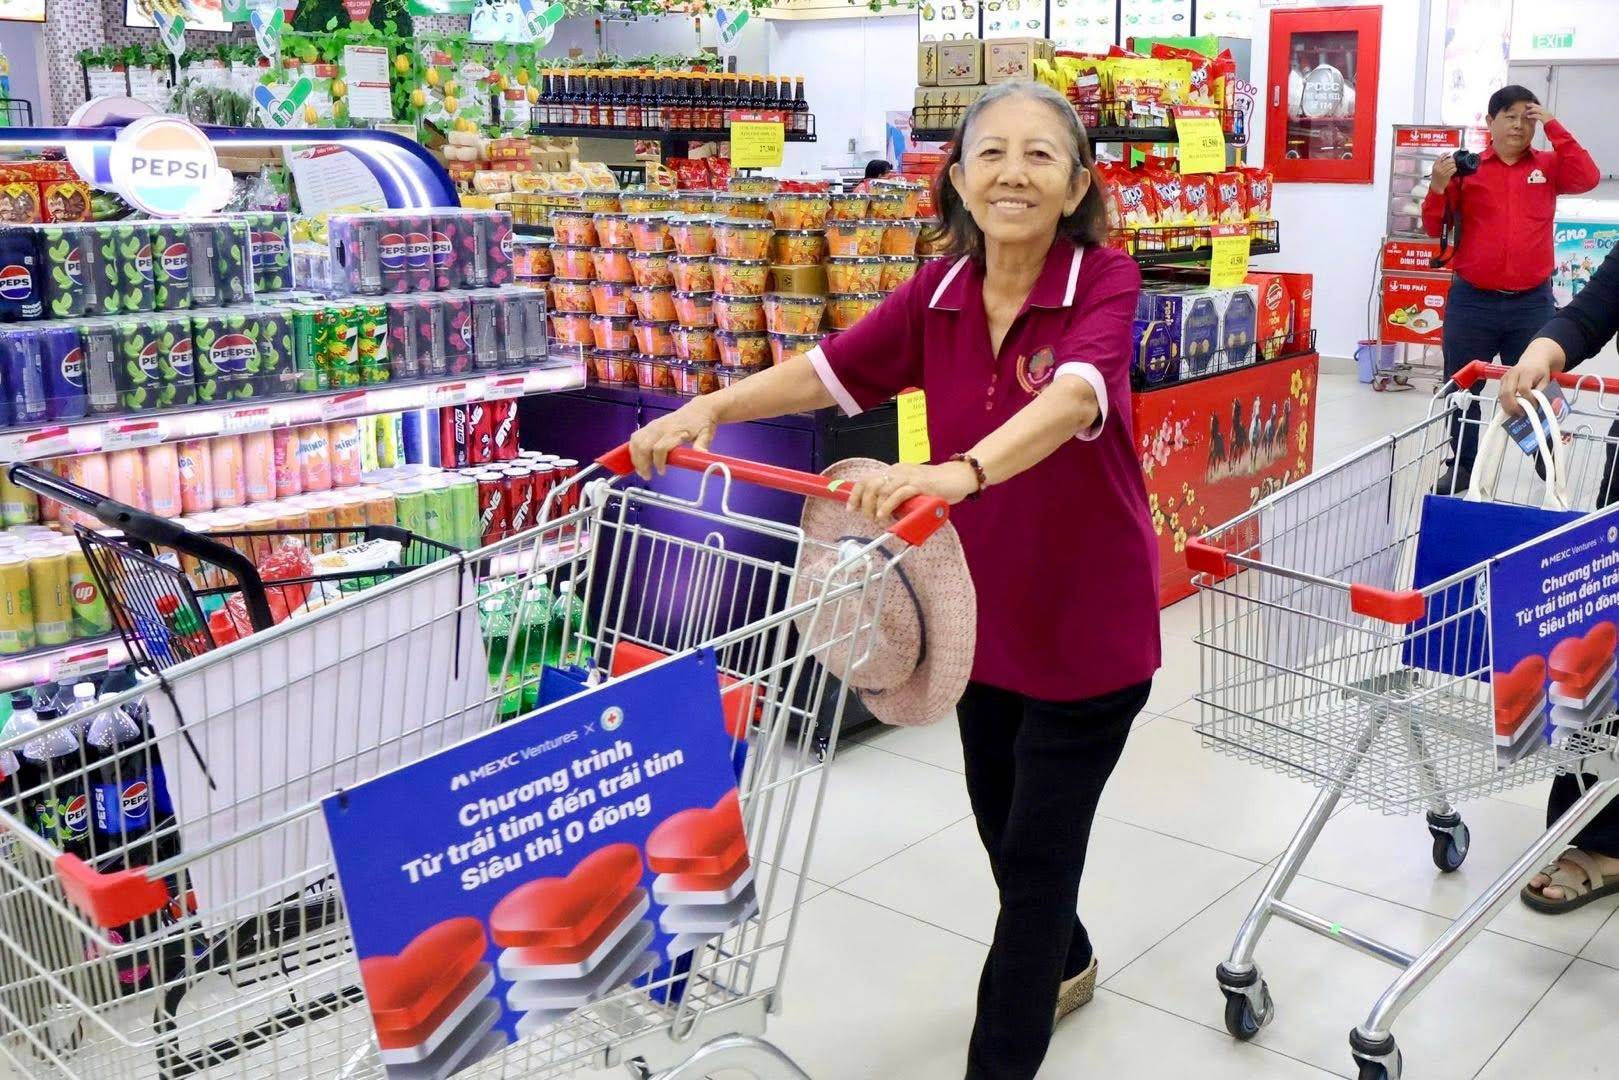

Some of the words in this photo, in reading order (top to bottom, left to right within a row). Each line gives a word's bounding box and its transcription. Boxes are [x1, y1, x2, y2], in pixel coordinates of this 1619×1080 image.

[1536, 31, 1569, 49] EXIT
[131, 157, 207, 180] PEPSI
[380, 246, 406, 255] PEPS
[0, 278, 30, 288] PEPS
[454, 408, 466, 445] STING
[1549, 548, 1572, 564] MEXC
[1572, 538, 1598, 555] Ventures
[75, 586, 94, 600] up
[1541, 563, 1590, 595] Chương
[1515, 606, 1533, 627] Từ
[1534, 596, 1556, 617] trái
[1557, 589, 1577, 607] tim
[1578, 578, 1601, 599] đến
[1538, 614, 1565, 639] Siêu
[1566, 604, 1584, 623] thị
[469, 752, 521, 783] MEXC
[520, 729, 579, 760] Ventures
[458, 766, 569, 827] Chương
[571, 739, 634, 778] trình
[67, 808, 88, 822] PEP
[95, 788, 108, 830] PEPSI
[122, 793, 149, 808] PEPS
[401, 853, 443, 884] Từ
[448, 827, 496, 866] trái
[499, 810, 544, 843] tim
[547, 785, 596, 821] đến
[599, 761, 642, 800] trái
[645, 748, 685, 779] tim
[460, 851, 522, 891] Siêu
[524, 828, 564, 856] thị
[588, 792, 652, 834] đồng
